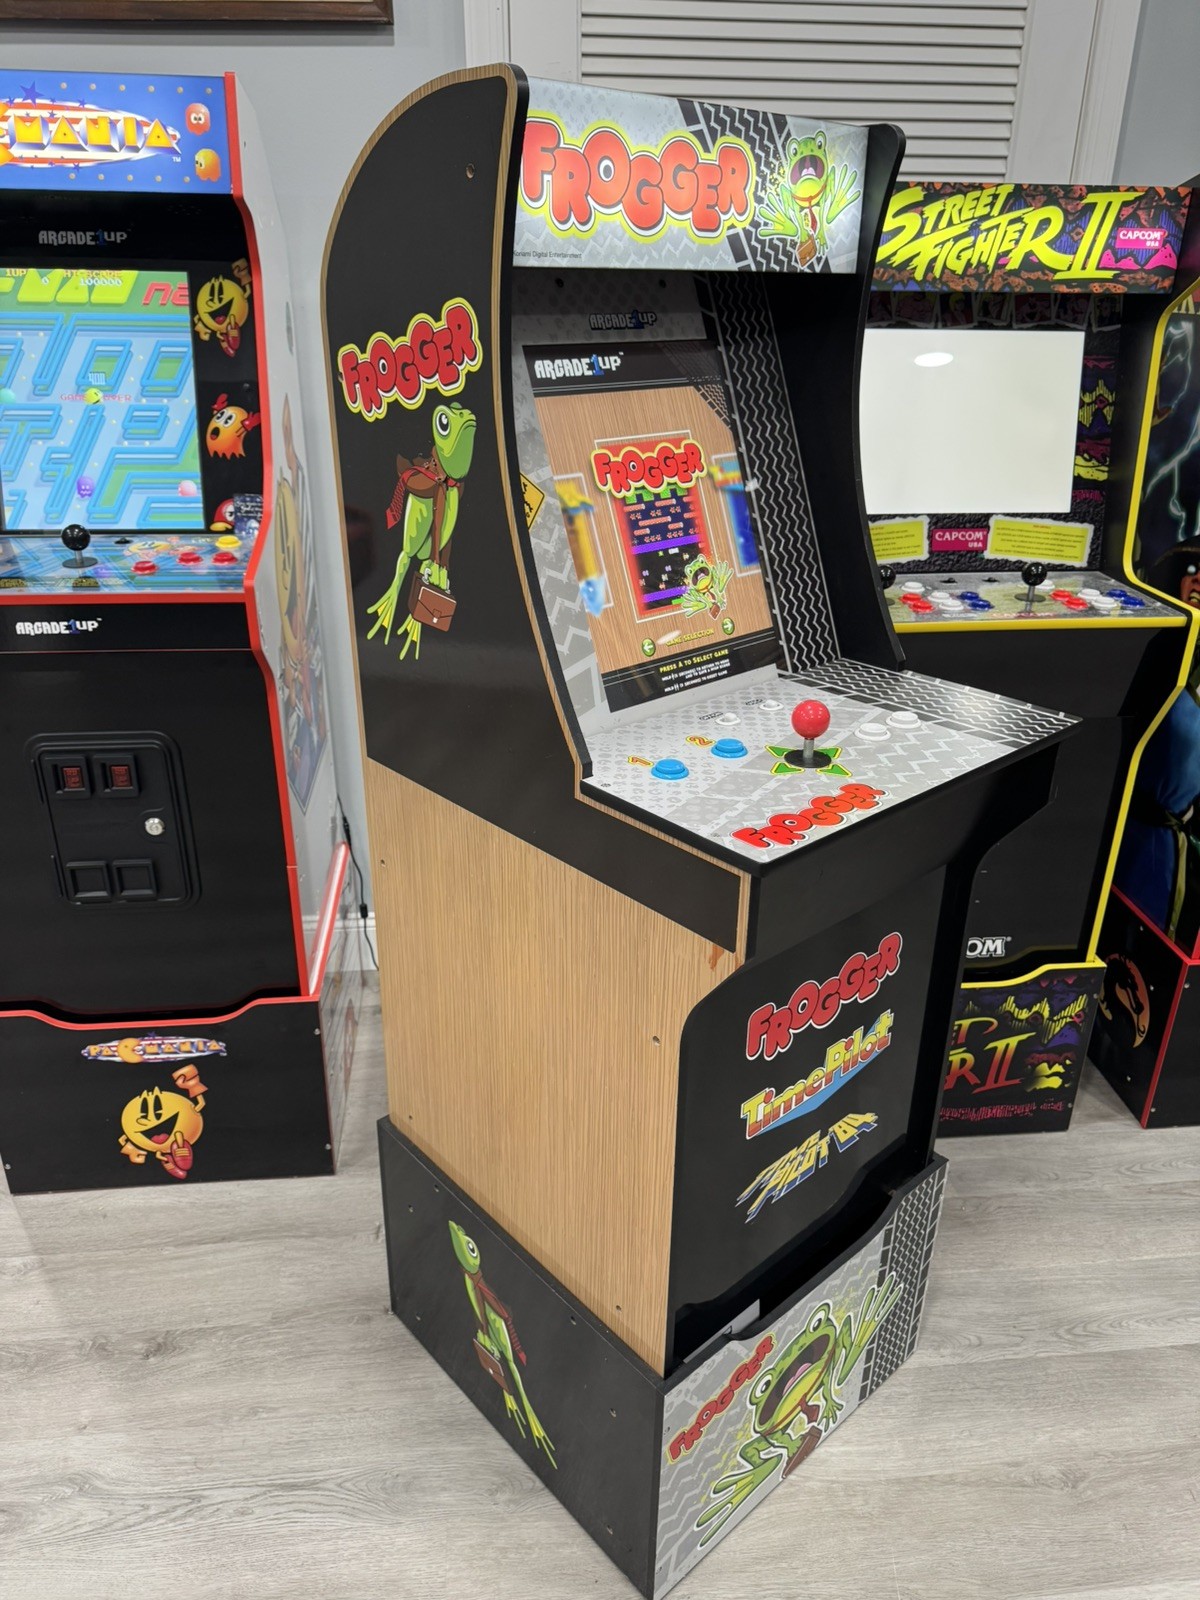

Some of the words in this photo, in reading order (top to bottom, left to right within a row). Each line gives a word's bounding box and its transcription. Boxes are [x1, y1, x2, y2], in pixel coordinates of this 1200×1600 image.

[7, 115, 182, 155] MANIA
[521, 117, 752, 234] FROGGER
[876, 184, 1015, 263] STREET
[888, 205, 1075, 281] FIGHTER
[1053, 191, 1148, 280] II
[1119, 229, 1161, 241] CAPCOM
[532, 250, 548, 259] Digital
[339, 300, 481, 419] FROGGER
[534, 354, 622, 380] ARCADE1UP
[592, 441, 706, 497] FROGGER
[935, 530, 984, 542] CAPCOM
[967, 541, 983, 549] USA
[16, 618, 99, 636] ARCADE1UP
[683, 628, 714, 642] SELECTION
[659, 663, 678, 673] PRESS
[692, 653, 713, 664] SELECT
[713, 648, 729, 658] GAME
[686, 735, 715, 748] 2
[731, 783, 889, 849] FROGGER
[746, 932, 902, 1060] FROGGER
[668, 1334, 775, 1463] FROGGER
